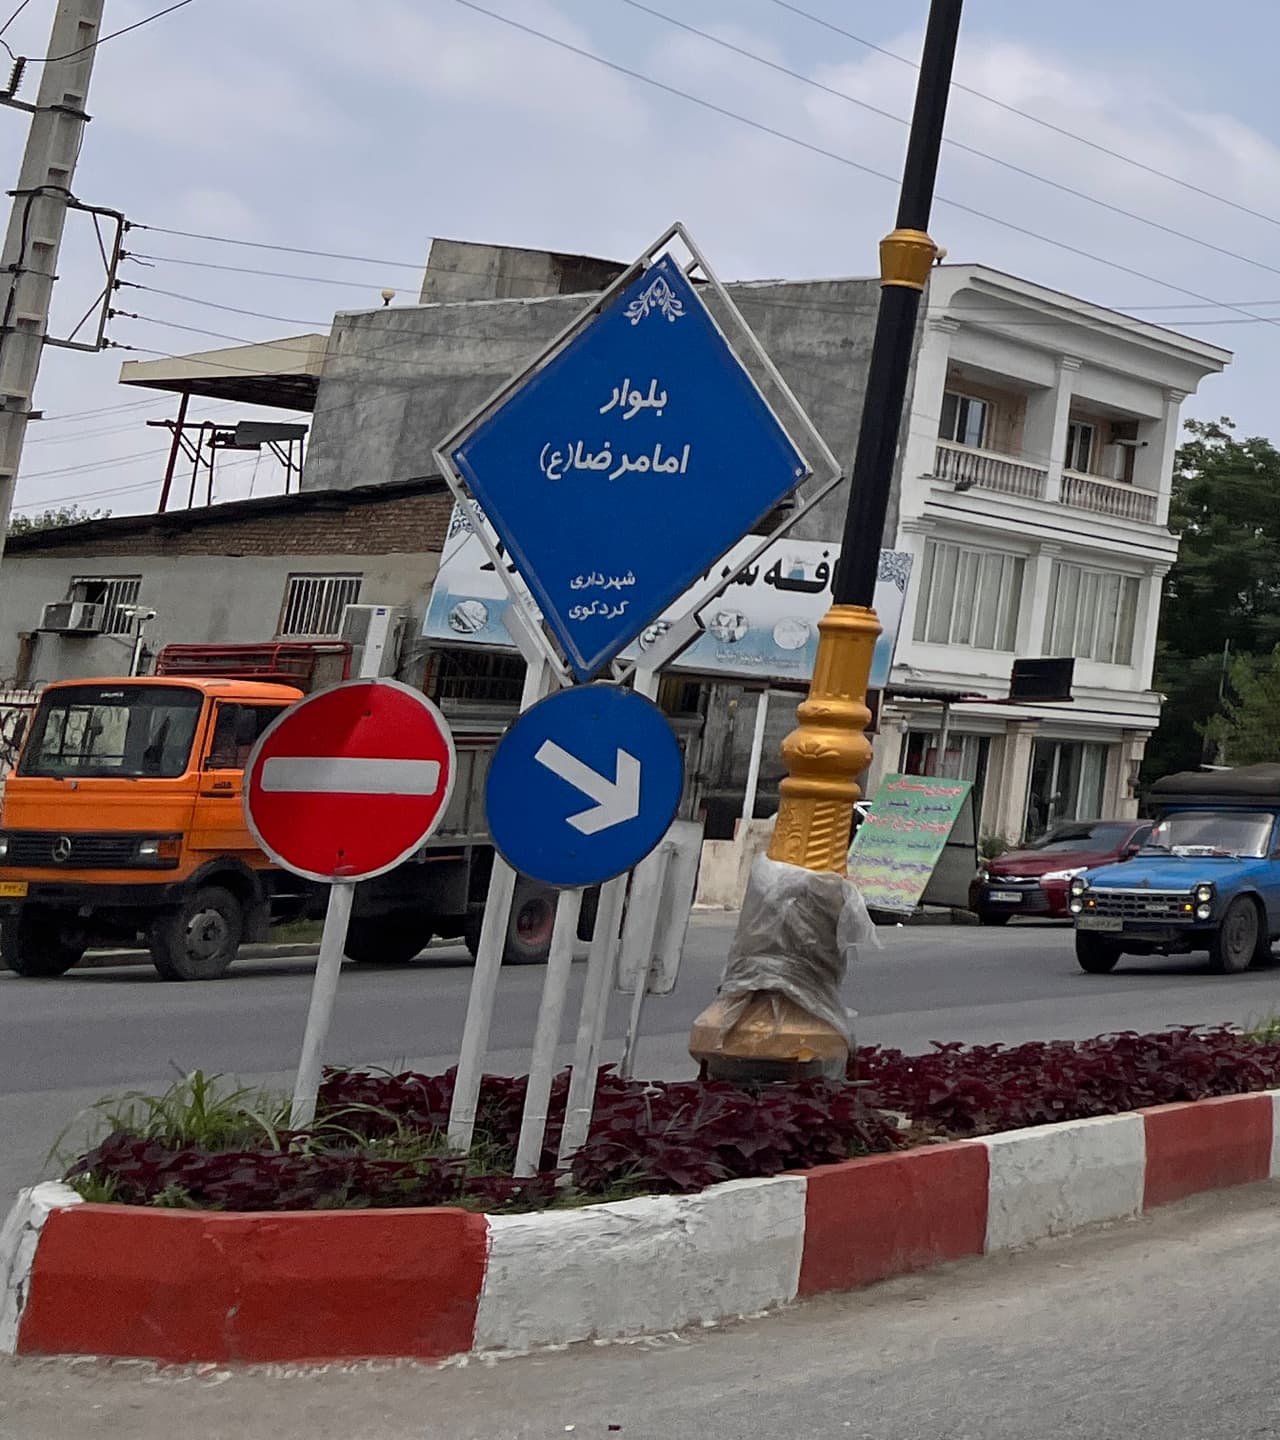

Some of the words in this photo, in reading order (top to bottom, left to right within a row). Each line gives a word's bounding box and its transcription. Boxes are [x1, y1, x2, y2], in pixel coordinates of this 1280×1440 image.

[599, 378, 667, 420] بلوار
[570, 570, 636, 590] شهرداری
[568, 600, 630, 621] کردکوی
